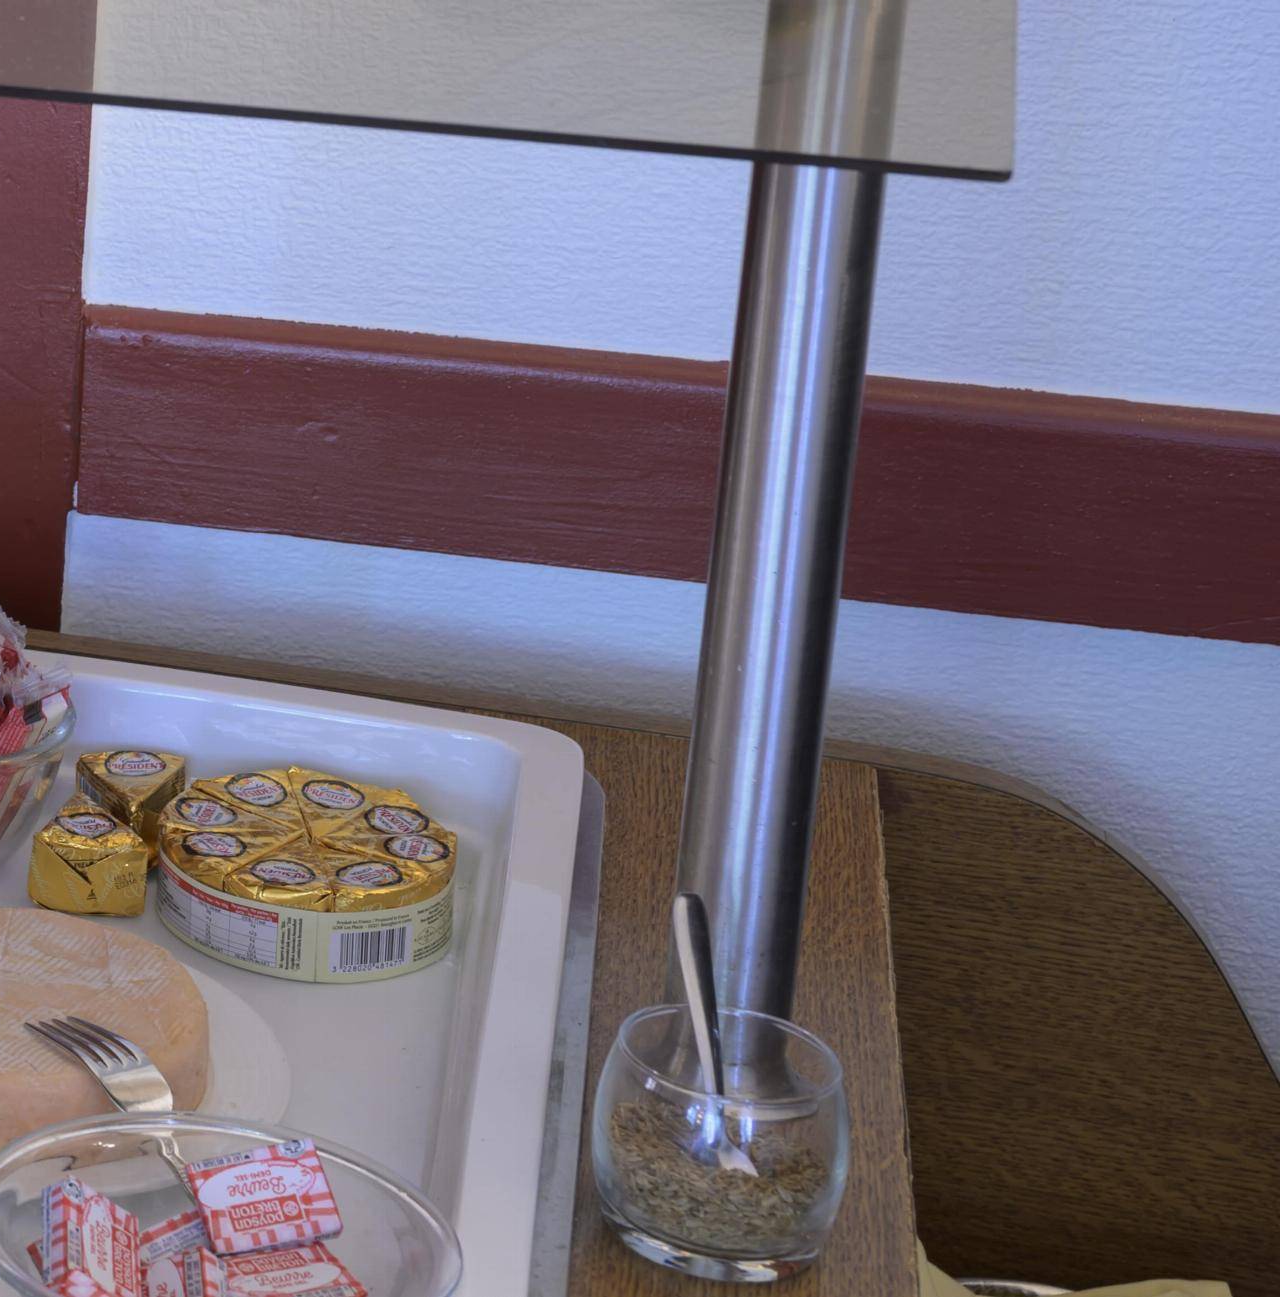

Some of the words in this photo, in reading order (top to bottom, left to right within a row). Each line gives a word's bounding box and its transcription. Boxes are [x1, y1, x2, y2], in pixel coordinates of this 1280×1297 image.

[227, 1176, 287, 1197] Beurre
[234, 1212, 284, 1230] paysan
[254, 1270, 313, 1287] Beurre
